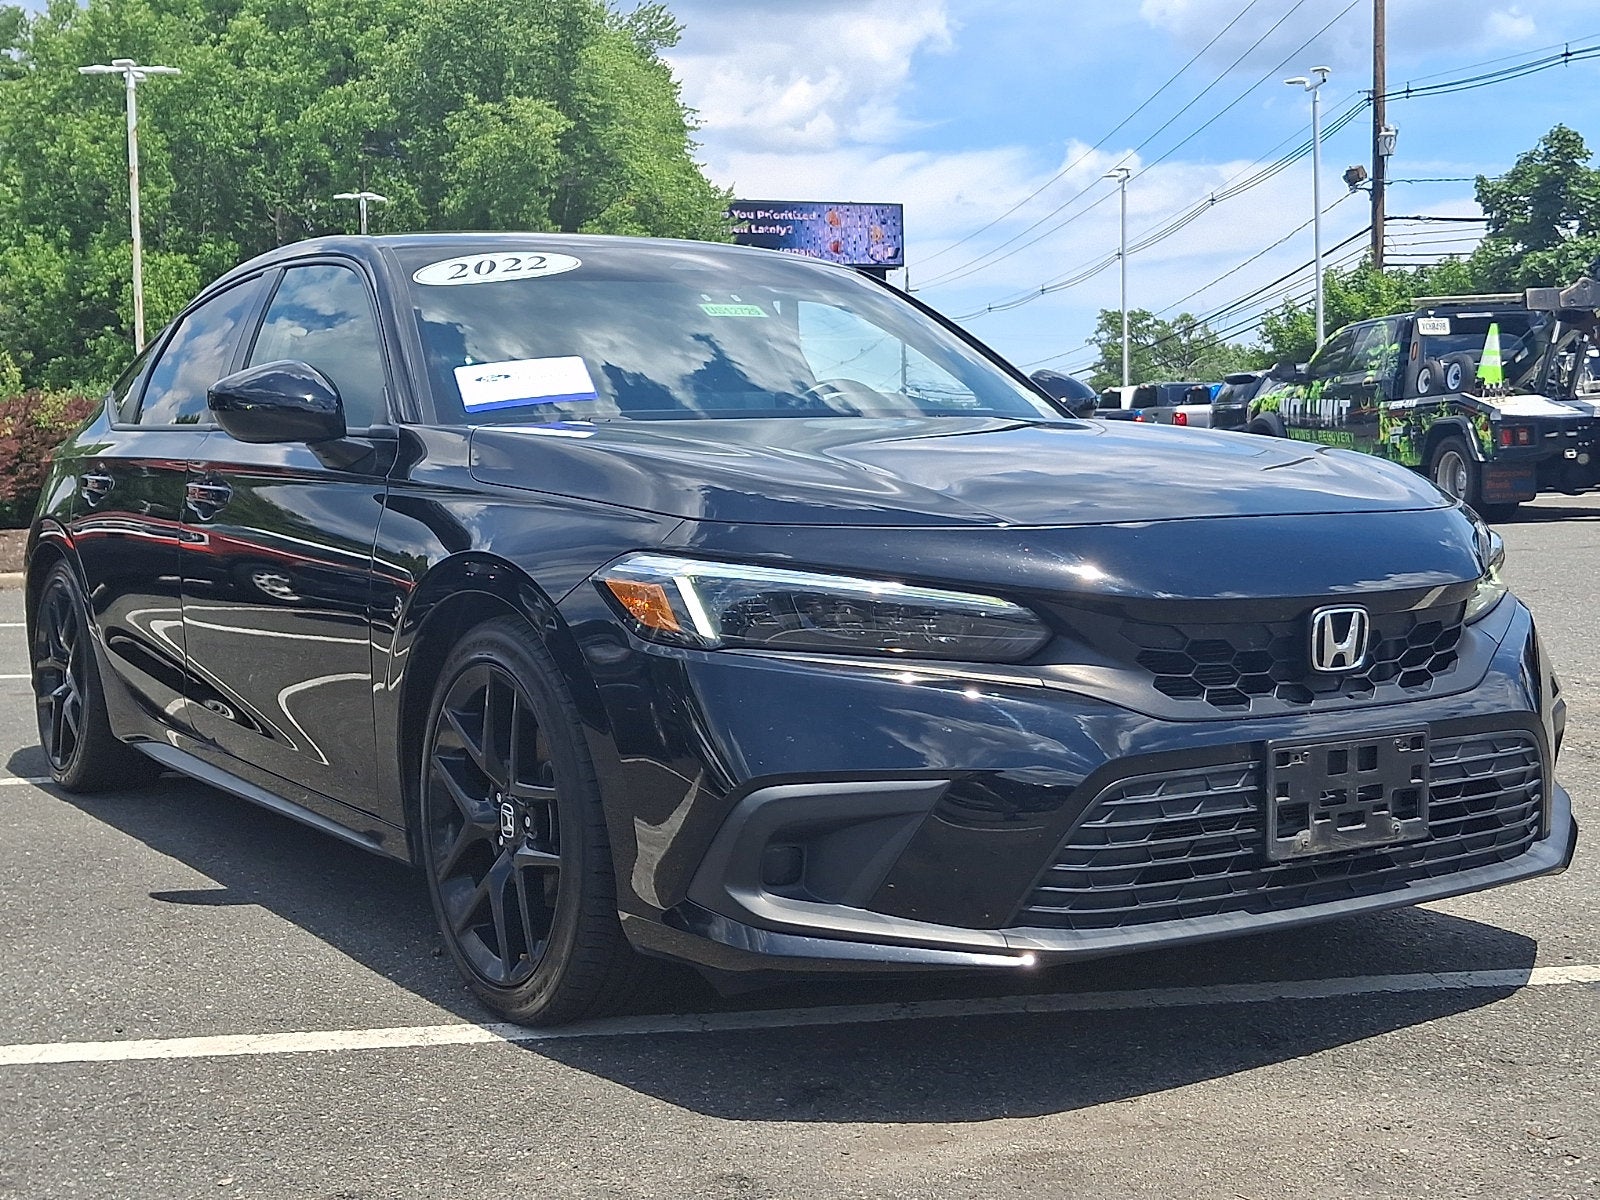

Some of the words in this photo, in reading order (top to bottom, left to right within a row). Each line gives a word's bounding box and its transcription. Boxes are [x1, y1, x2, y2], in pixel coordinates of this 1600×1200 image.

[731, 210, 754, 220] You
[757, 209, 818, 220] Prioritized
[752, 225, 794, 236] Lately?
[447, 255, 548, 281] 2022
[1306, 398, 1351, 428] LIMIT
[1318, 431, 1355, 443] RECOVERY
